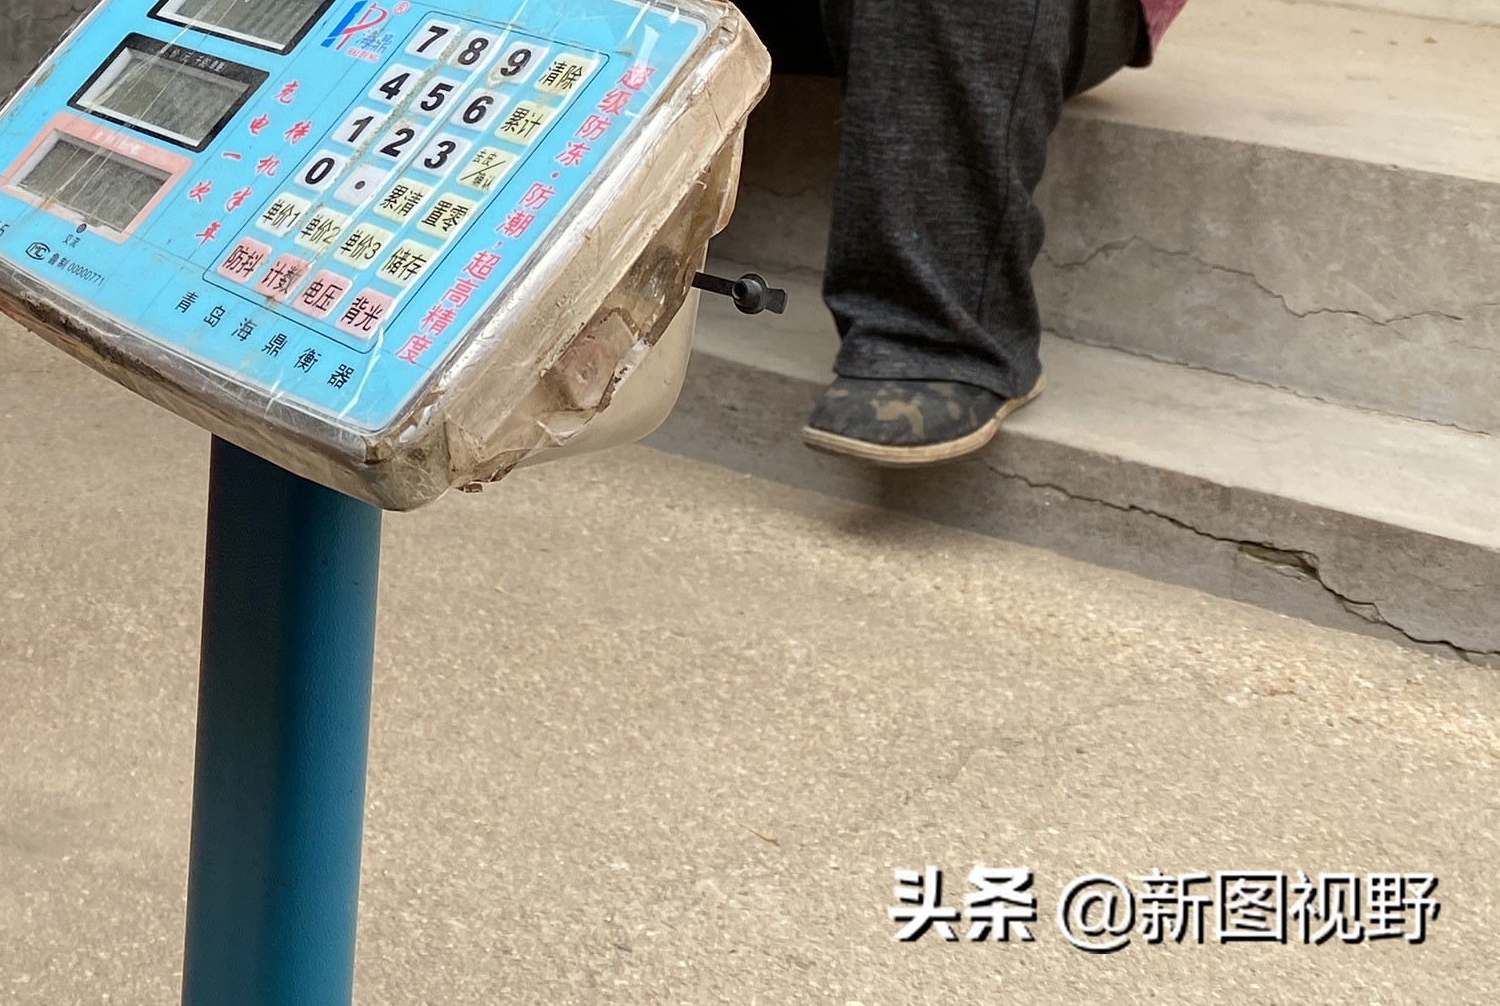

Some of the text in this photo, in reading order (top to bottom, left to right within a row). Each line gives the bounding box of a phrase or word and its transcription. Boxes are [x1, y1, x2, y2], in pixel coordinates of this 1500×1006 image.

[416, 25, 449, 53] 7
[457, 37, 489, 65] 8
[500, 48, 532, 77] 9
[538, 60, 583, 91] 清除
[379, 72, 411, 100] 4
[420, 82, 454, 111] 5
[462, 95, 494, 124] 6
[500, 107, 542, 138] 累计
[347, 116, 374, 143] 1
[380, 128, 415, 158] 2
[423, 140, 457, 170] 3
[304, 157, 335, 185] 0
[262, 200, 300, 228] 单价1
[380, 184, 424, 217] 累清
[422, 199, 469, 232] 置零
[301, 215, 342, 245] 单价2
[340, 229, 382, 260] 单价3
[225, 245, 263, 278] 防抖
[383, 247, 427, 281] 储存
[261, 261, 302, 295] 计数
[302, 278, 343, 312] 电压
[342, 296, 383, 332] 背光
[174, 291, 355, 390] 青岛海鼎衡器
